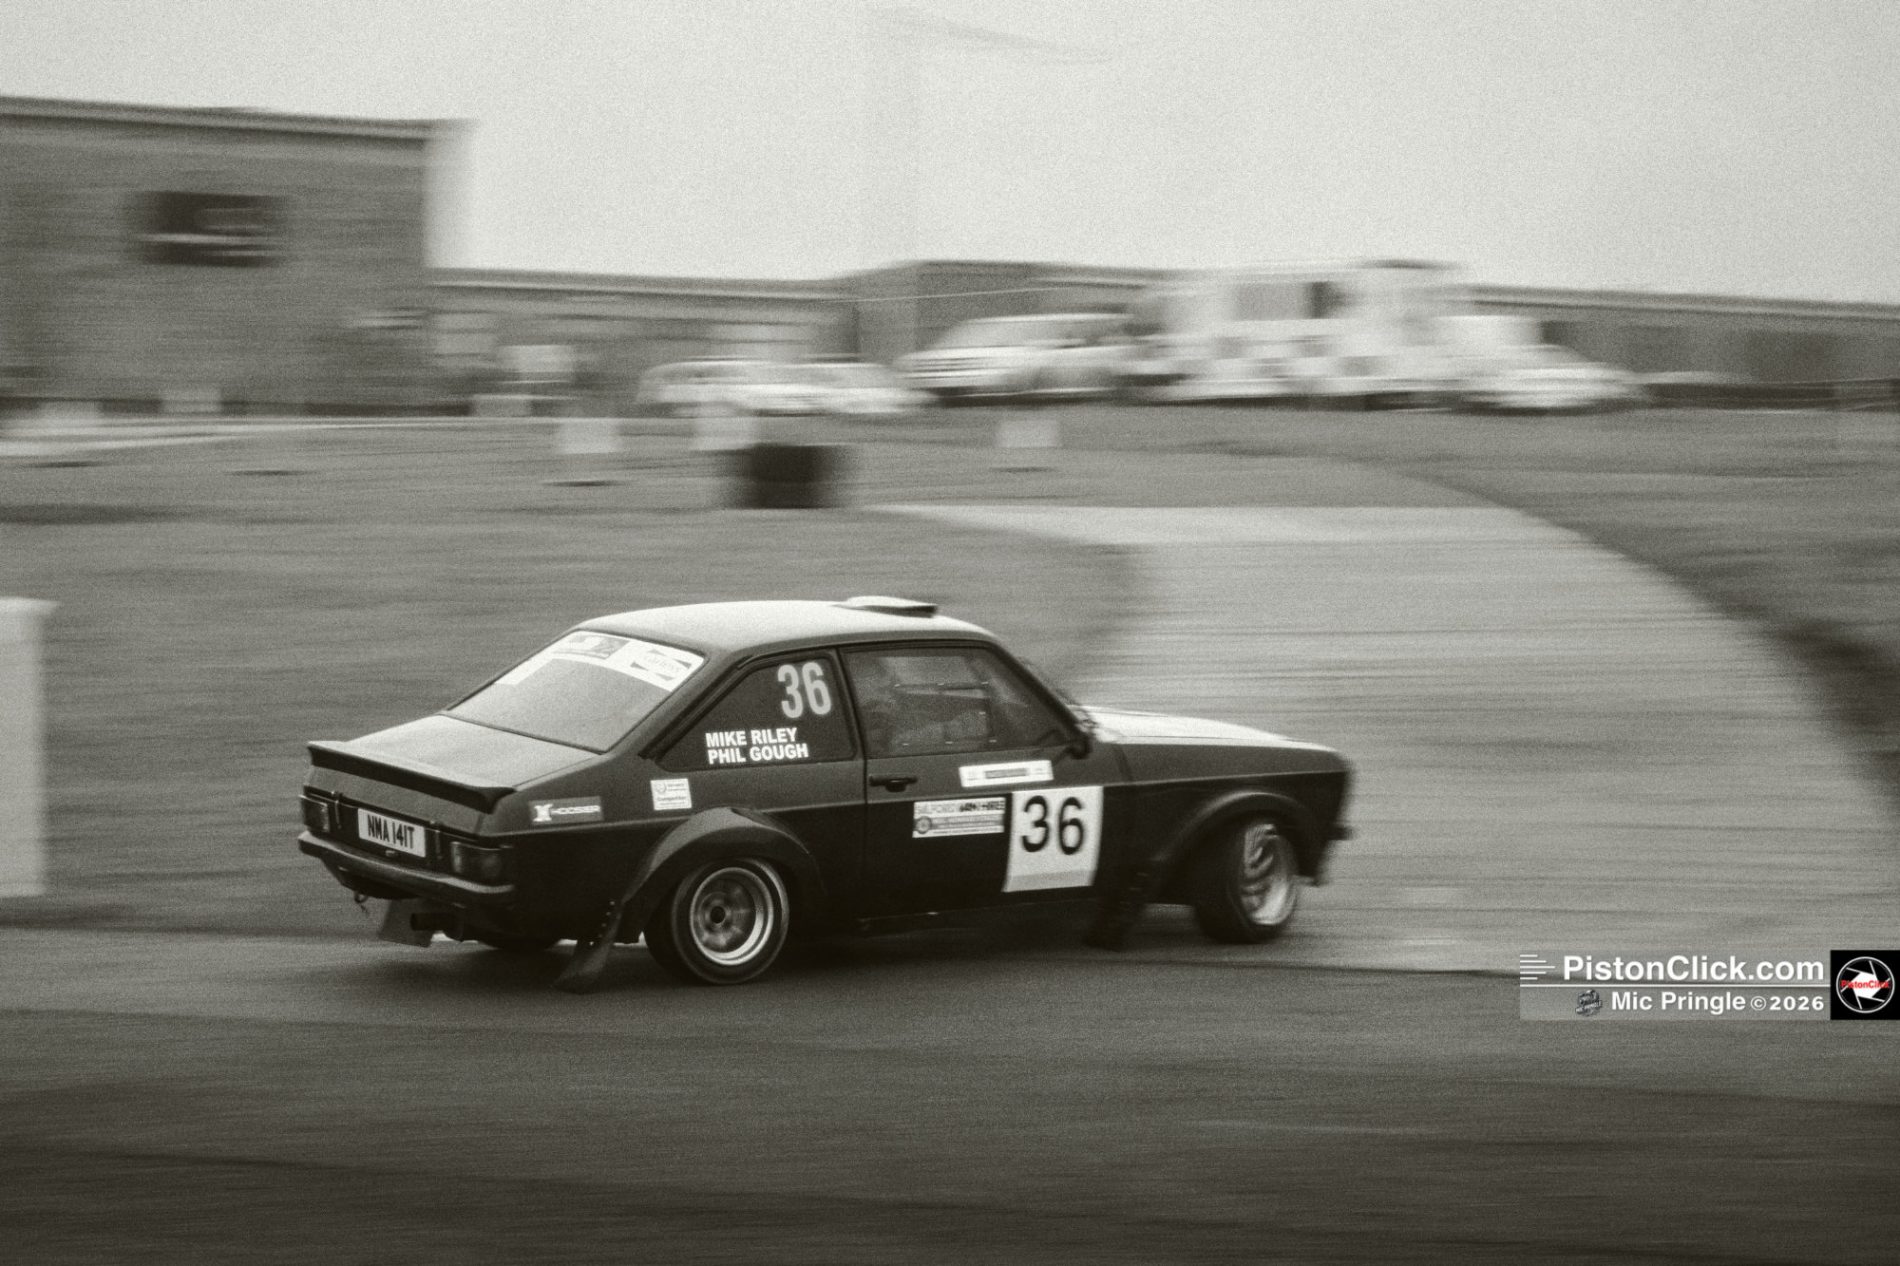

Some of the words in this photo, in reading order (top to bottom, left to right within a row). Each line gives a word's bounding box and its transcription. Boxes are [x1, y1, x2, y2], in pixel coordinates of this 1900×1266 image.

[777, 661, 832, 719] 36
[705, 730, 747, 748] MIKE
[750, 727, 798, 745] RILEY
[707, 747, 747, 765] PHIL
[749, 743, 809, 762] GOUGH
[1022, 795, 1085, 856] 36
